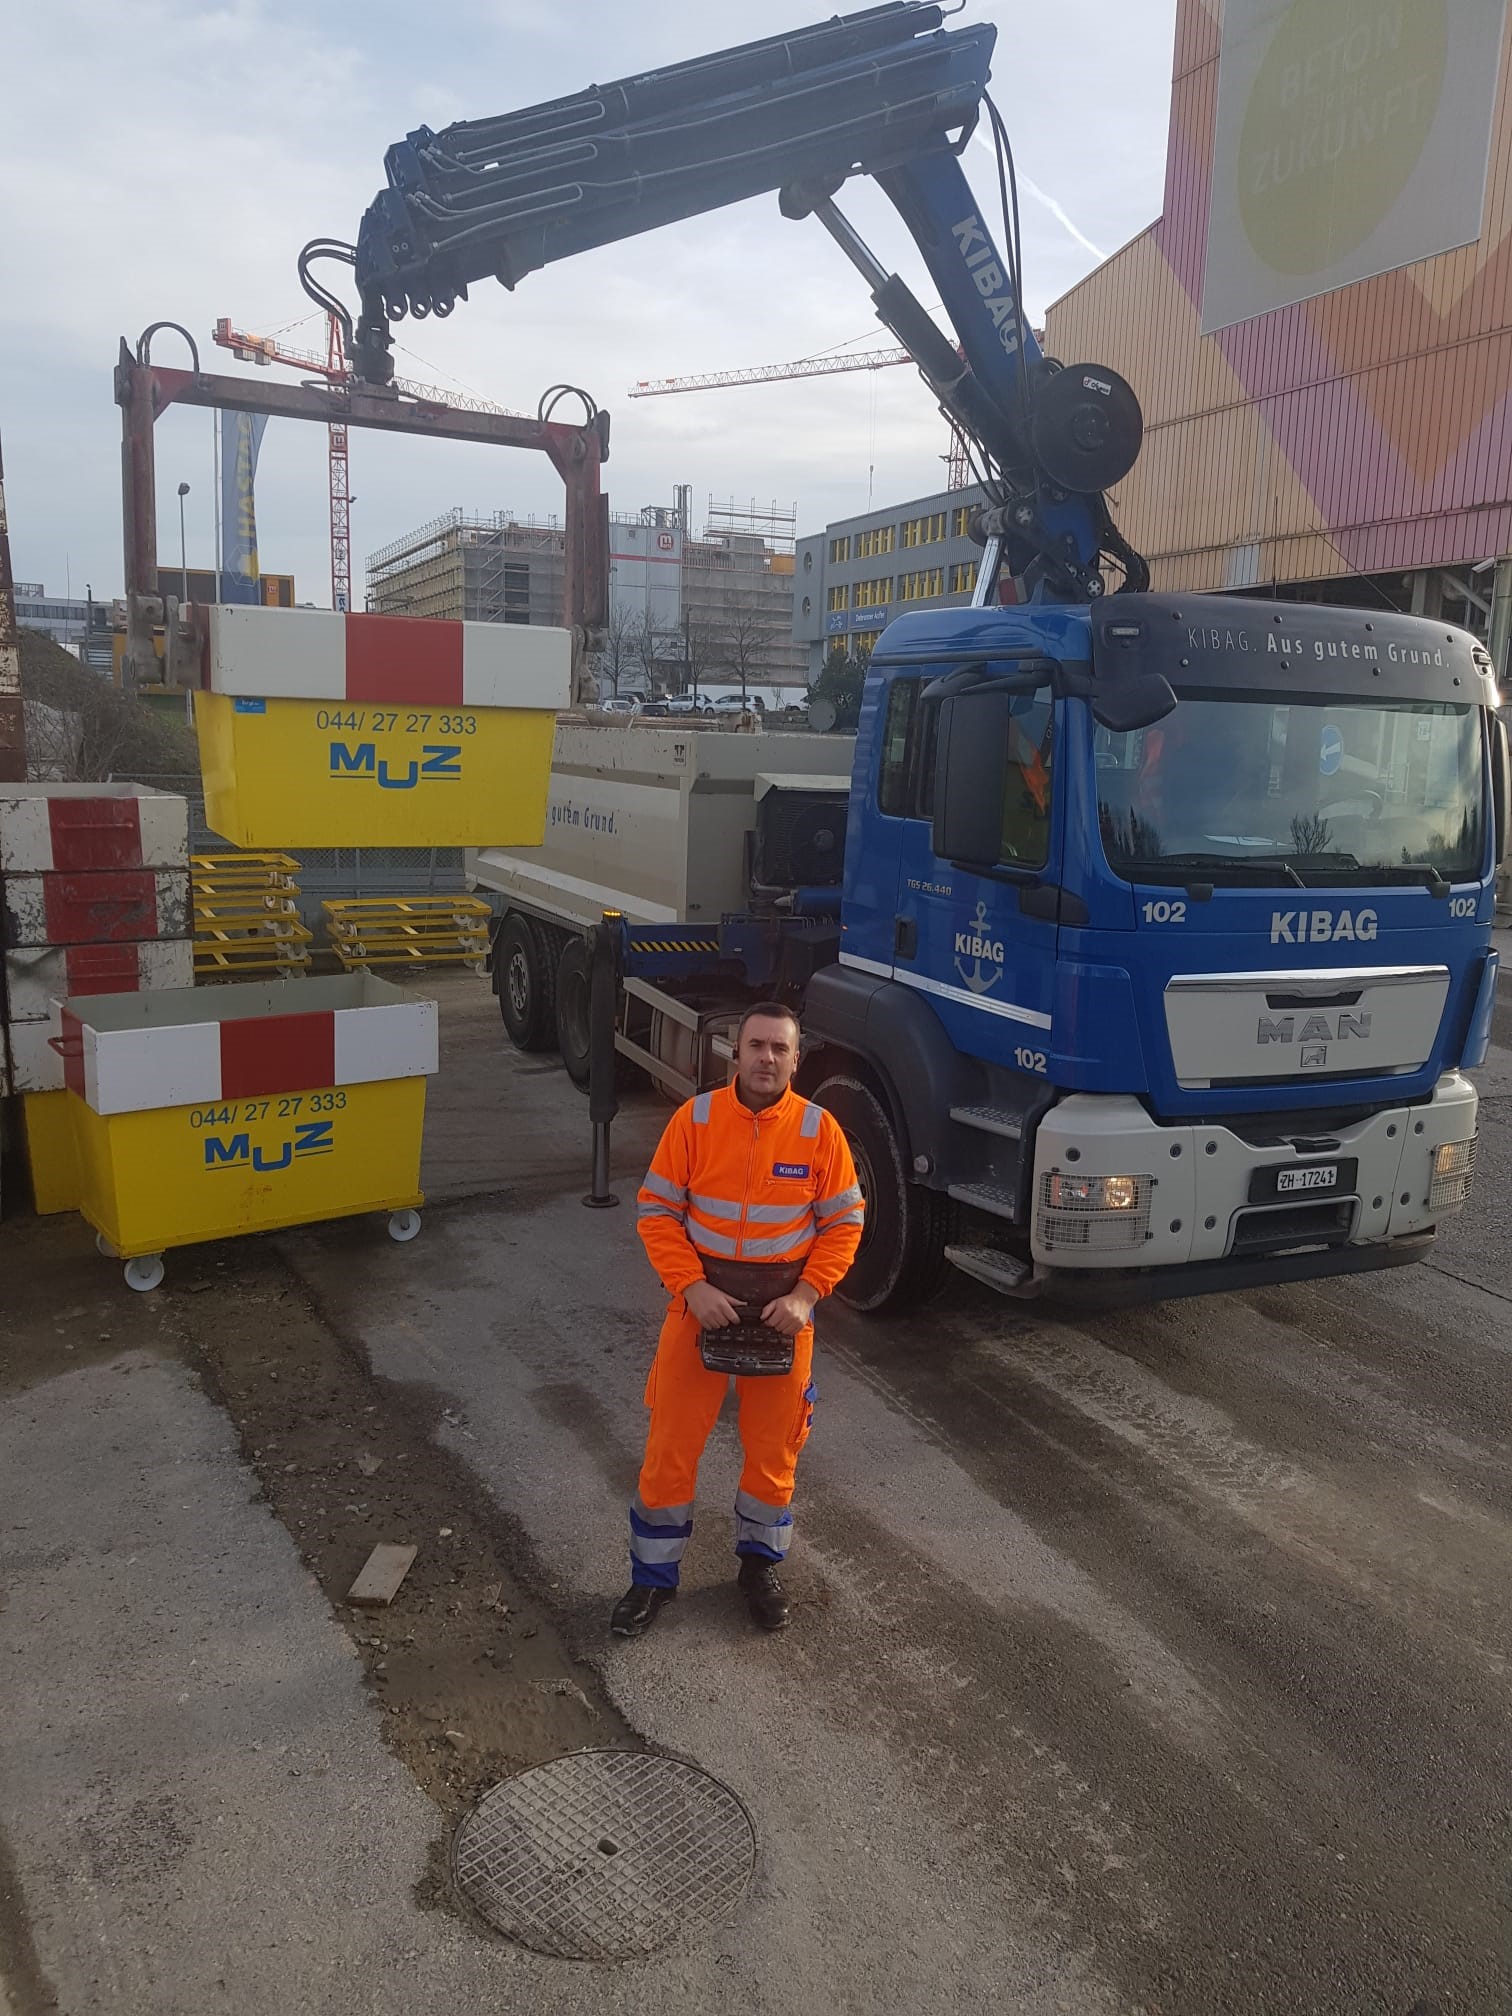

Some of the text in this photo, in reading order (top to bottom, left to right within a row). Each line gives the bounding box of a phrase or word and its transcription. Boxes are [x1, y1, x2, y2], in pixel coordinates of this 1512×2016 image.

[1280, 4, 1403, 108] BETON
[1251, 73, 1430, 195] ZUKUNFT
[951, 215, 1028, 355] KIBAG
[1187, 628, 1451, 668] KIBAG. Aus gutem Grund.
[316, 710, 477, 734] 044/ 27 27 333
[329, 742, 462, 789] MUZ
[551, 806, 618, 835] gutem Grund.
[907, 878, 952, 896] TGS 26.440
[1142, 901, 1187, 924] 102
[1449, 898, 1477, 918] 102
[1270, 909, 1378, 944] KIBAG
[955, 932, 1005, 963] KIBAG
[1257, 1011, 1373, 1044] MAN
[1014, 1047, 1048, 1074] 102
[190, 1091, 347, 1128] 044/ 27 27 333
[204, 1120, 334, 1172] MUZ
[779, 1166, 804, 1176] KIBAG
